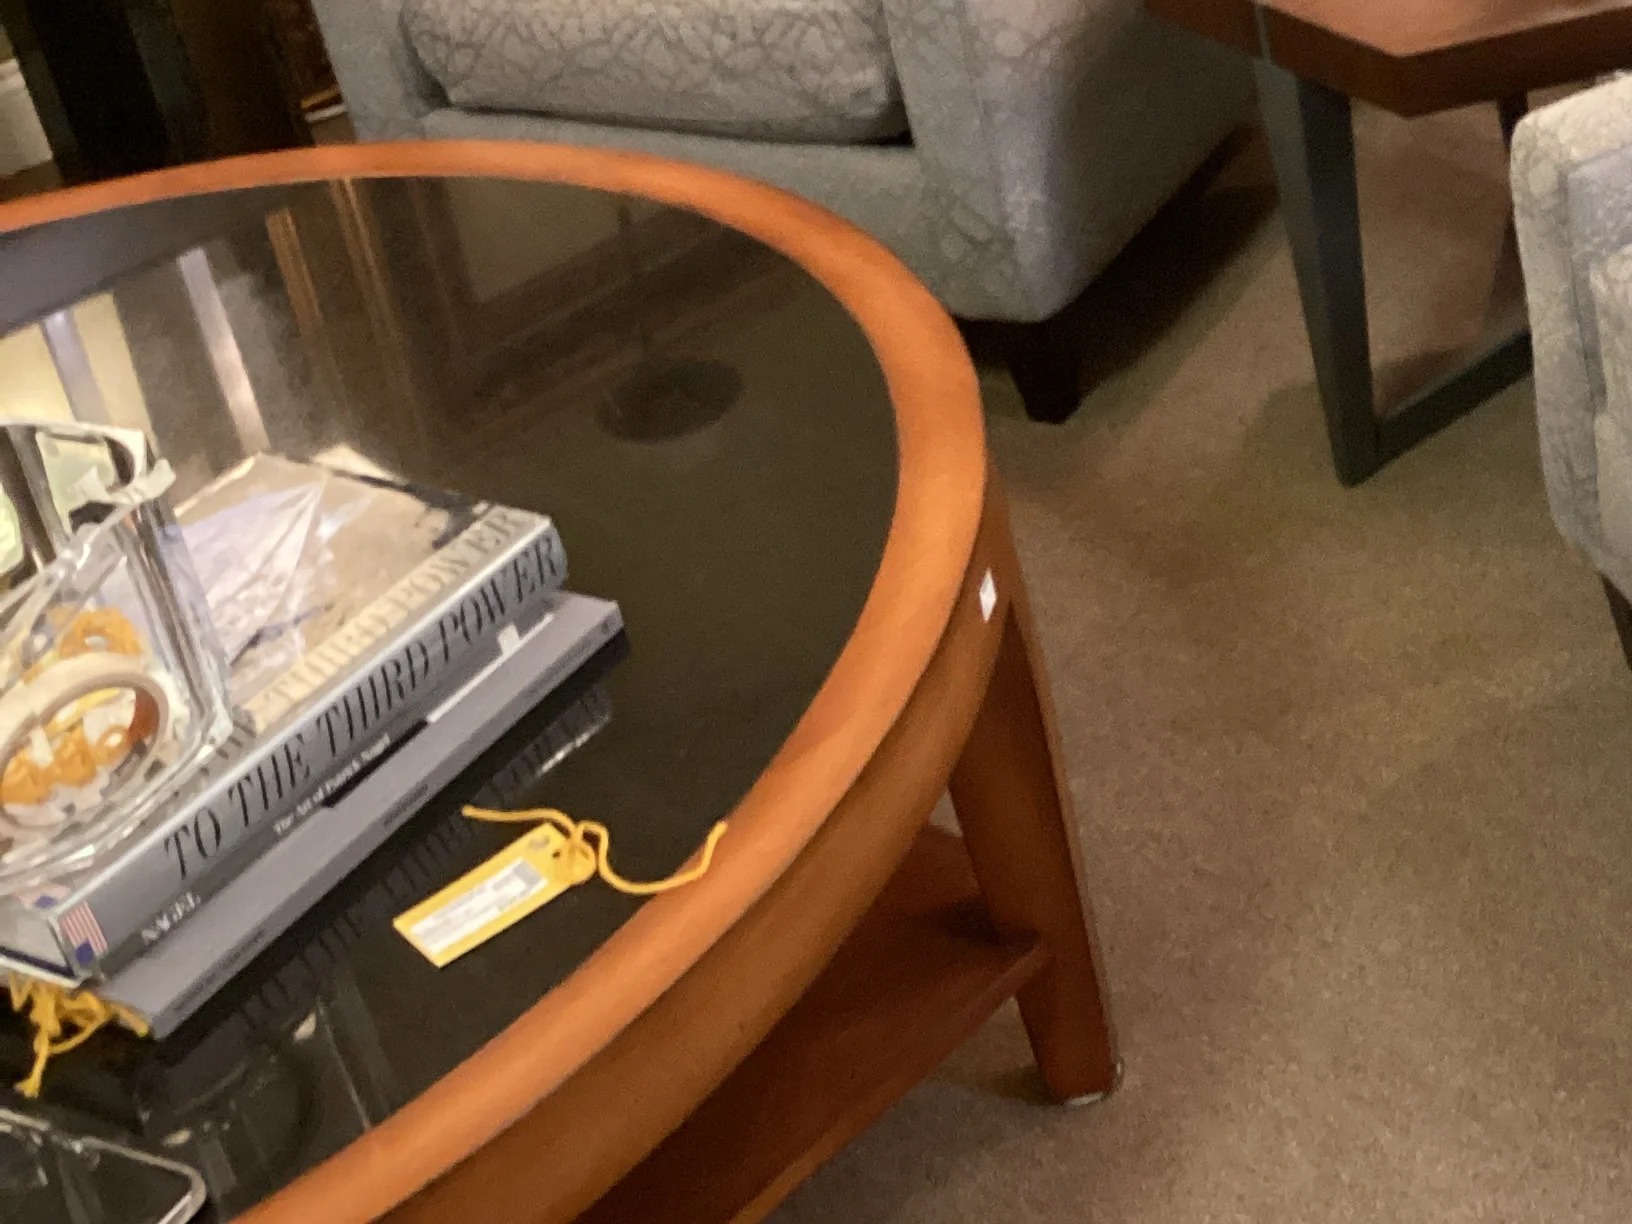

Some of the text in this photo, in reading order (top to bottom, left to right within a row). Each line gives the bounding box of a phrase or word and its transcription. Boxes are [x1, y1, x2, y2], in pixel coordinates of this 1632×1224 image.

[163, 806, 222, 880] TO
[228, 732, 311, 827] THE
[315, 640, 429, 757] THIRD
[438, 535, 558, 664] POWER
[264, 513, 518, 700] THIRD POWER
